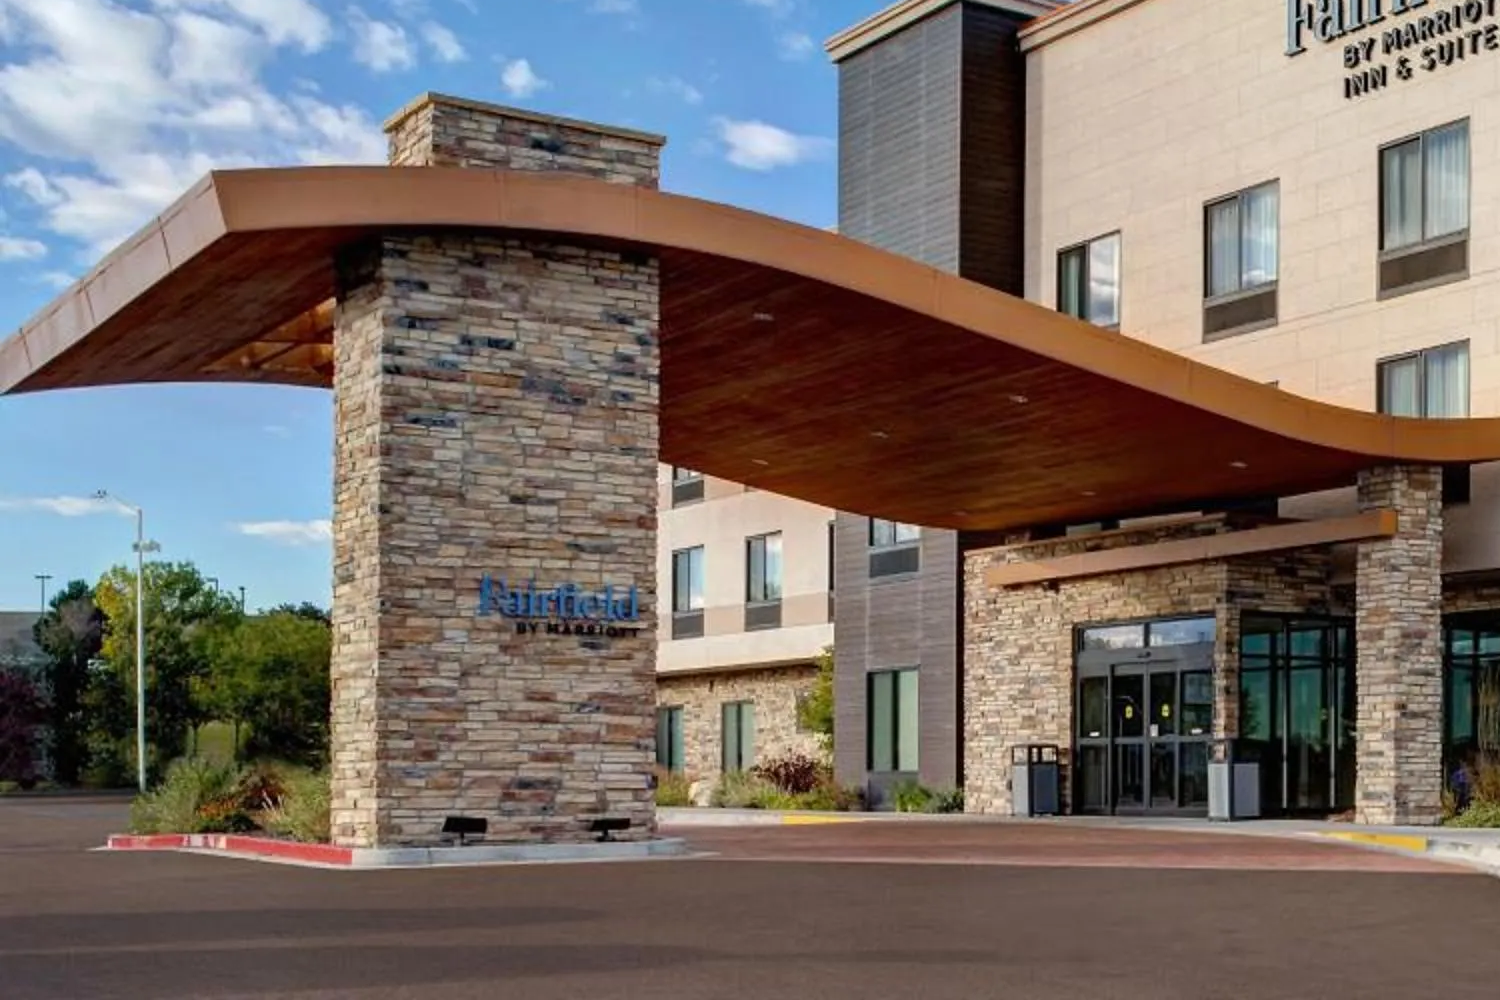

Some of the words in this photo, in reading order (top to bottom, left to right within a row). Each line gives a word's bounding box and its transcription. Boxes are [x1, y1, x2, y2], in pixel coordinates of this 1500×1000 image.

[1344, 37, 1376, 68] BY
[1343, 65, 1387, 99] INN
[1396, 56, 1413, 80] &
[477, 571, 640, 621] Fairfield
[515, 622, 538, 635] BY
[546, 622, 641, 638] MARRIOTT
